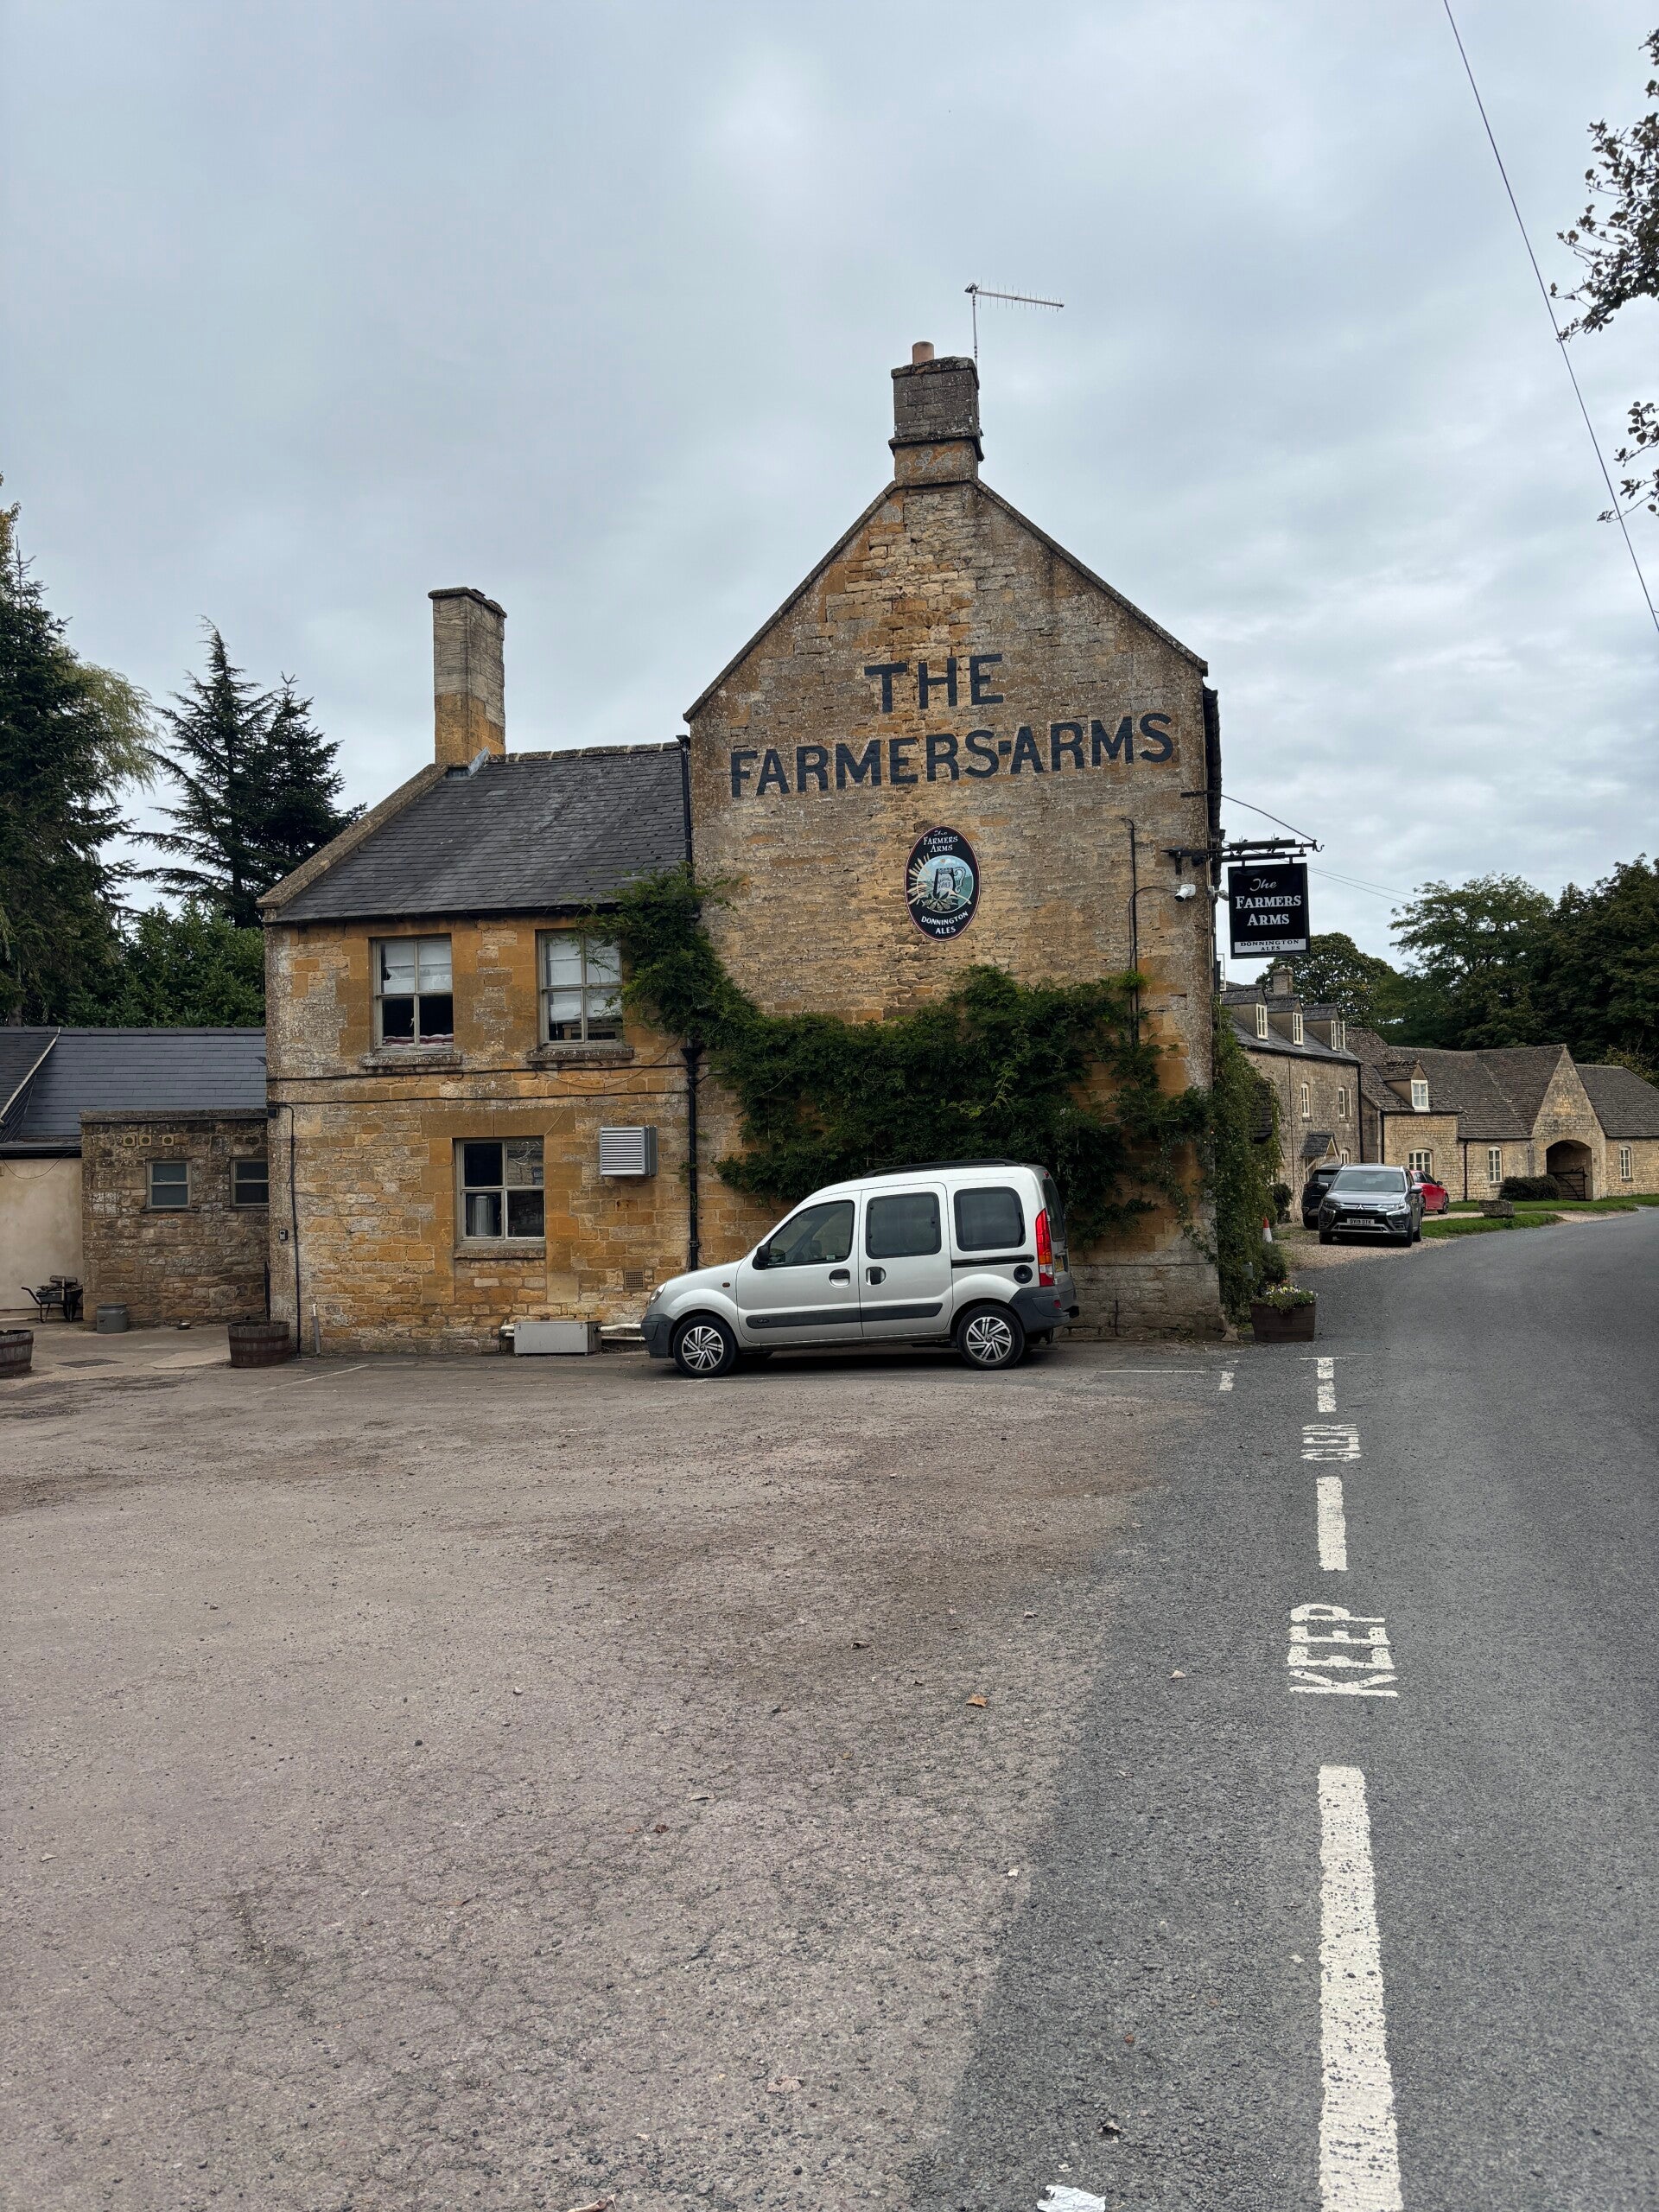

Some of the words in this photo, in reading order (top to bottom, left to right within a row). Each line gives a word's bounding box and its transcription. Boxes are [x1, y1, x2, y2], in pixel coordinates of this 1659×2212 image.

[864, 652, 1004, 713] THE
[923, 836, 958, 846] FARMERS
[931, 844, 953, 853] ARMS
[1249, 878, 1277, 892] The
[1235, 894, 1302, 910] FARMERS
[921, 911, 969, 925] DONNINGTON
[1247, 913, 1290, 926] ARMS
[935, 926, 957, 935] ALES
[1300, 1424, 1362, 1461] CLEAR
[1287, 1604, 1399, 1697] KEEP
